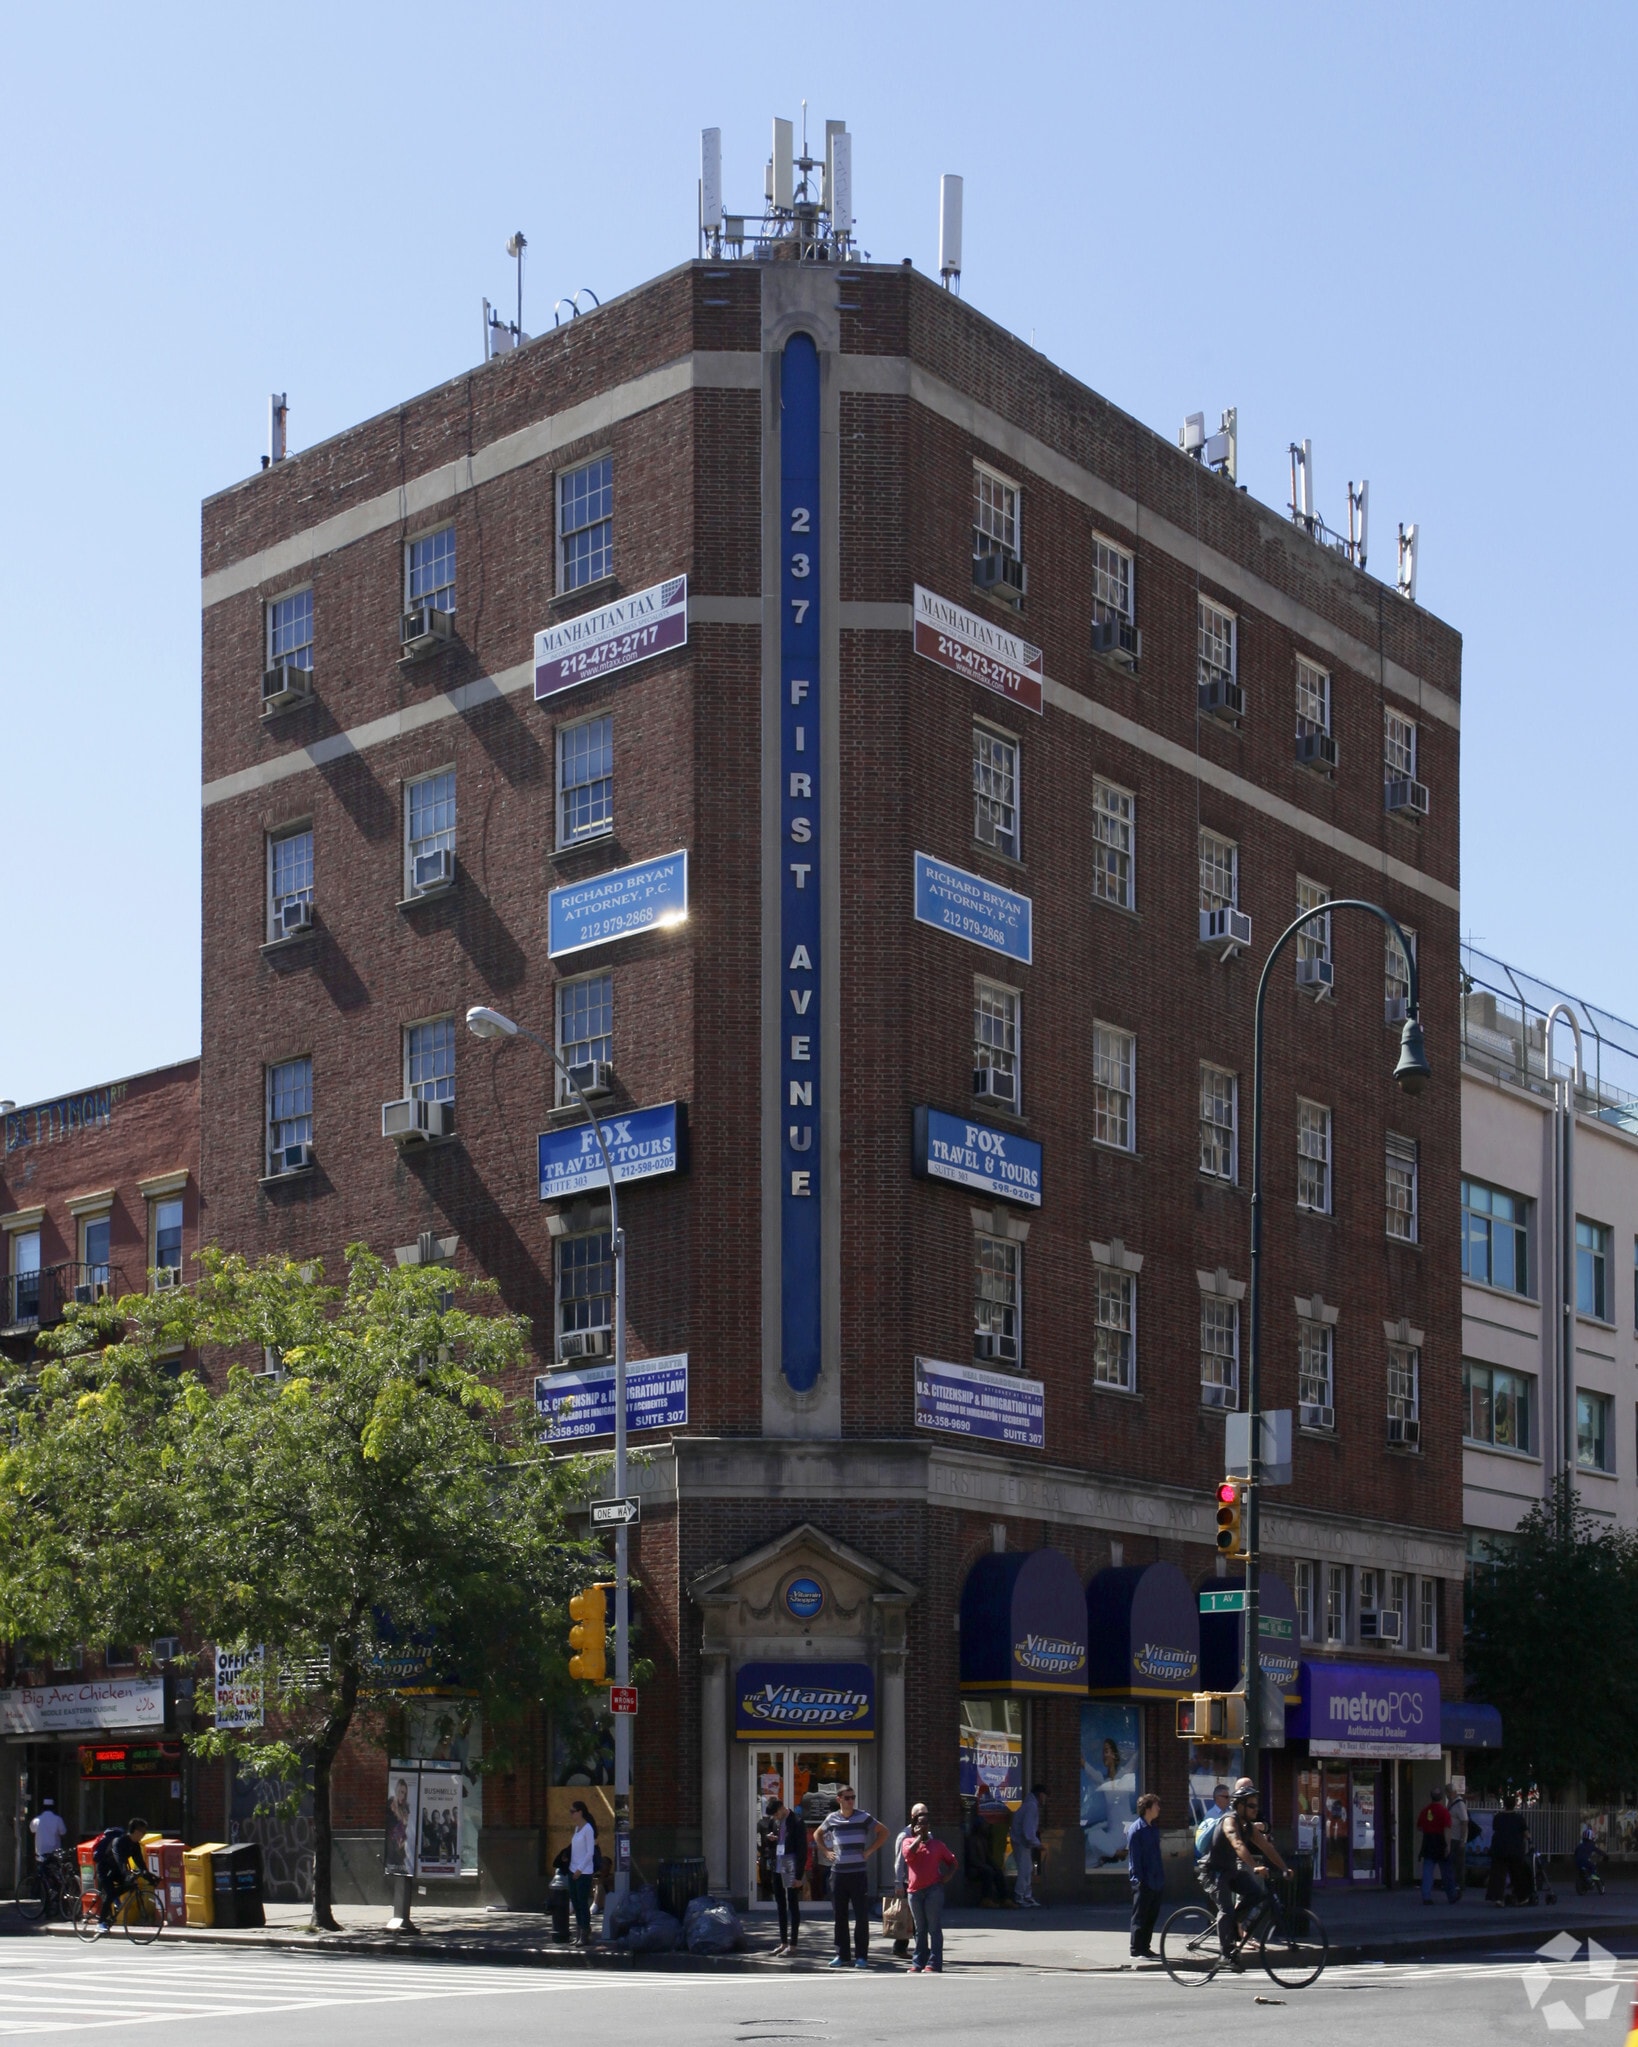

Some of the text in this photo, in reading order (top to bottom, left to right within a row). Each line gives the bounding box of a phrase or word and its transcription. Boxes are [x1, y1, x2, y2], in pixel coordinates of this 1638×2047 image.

[791, 507, 810, 623] 237
[542, 594, 655, 653] MANHATTAN TAX
[921, 594, 1018, 659] MANHATTAN TAX
[560, 625, 659, 677] 212-473-2717
[938, 636, 1021, 691] 212-473-2717
[579, 651, 638, 679] www.mtaxx.com
[955, 662, 1005, 692] www.mtaxx.com
[790, 680, 812, 889] FIRST
[561, 866, 674, 909] RICHARD BRYAN
[926, 867, 1021, 915] RICHARD BRYAN
[565, 883, 671, 921] ATTORNEY, P.C.
[929, 884, 1019, 928] ATTORNEY, P.C.
[581, 907, 653, 939] 212 979-2868
[943, 909, 1005, 945] 212 979-2868
[789, 944, 813, 1196] AVENUE
[580, 1120, 633, 1153] FOX
[965, 1125, 1006, 1157] FOX
[544, 1153, 604, 1179] TRAVEL
[618, 1136, 671, 1162] TOURS
[621, 1156, 674, 1177] 212-598-0205
[932, 1140, 1038, 1187] TRAVEL & TOURS
[544, 1176, 588, 1195] SUITE 303
[934, 1164, 968, 1181] SUITE 303
[992, 1181, 1035, 1201] 598-0205
[601, 1393, 607, 1403] &
[666, 1379, 685, 1395] LAW
[916, 1381, 1043, 1418] U.S. CITIZENSHIP & IMMIGRATION LAW
[583, 1408, 590, 1418] DE
[634, 1398, 668, 1411] ACCIDENTES
[635, 1410, 685, 1426] SUITE 307
[917, 1413, 971, 1431] 212-358-9690
[1003, 1428, 1043, 1444] SUITE 307
[935, 1467, 979, 1496] FIRST
[999, 1478, 1069, 1509] FEDERAL
[1086, 1489, 1155, 1522] SAVINGS
[1168, 1503, 1200, 1528] AND
[598, 1506, 632, 1519] ONE WAY
[1211, 1594, 1234, 1610] 1 AV
[1027, 1634, 1085, 1655] Vitamin
[1144, 1643, 1196, 1663] Vitamin
[1020, 1652, 1077, 1672] Shoppe
[1139, 1661, 1190, 1679] Shoppe
[22, 1690, 43, 1709] Big
[48, 1688, 74, 1705] Arc
[79, 1684, 133, 1701] Chicken
[765, 1684, 867, 1705] Vitamin
[1329, 1691, 1423, 1724] metroPCS
[40, 1705, 118, 1717] MIDDLE EASTERN CUISINE
[752, 1703, 854, 1722] Shoppe
[1347, 1725, 1407, 1738] Authorized Dealer
[1464, 1729, 1475, 1739] 237
[424, 1787, 457, 1796] BUSHMILLS
